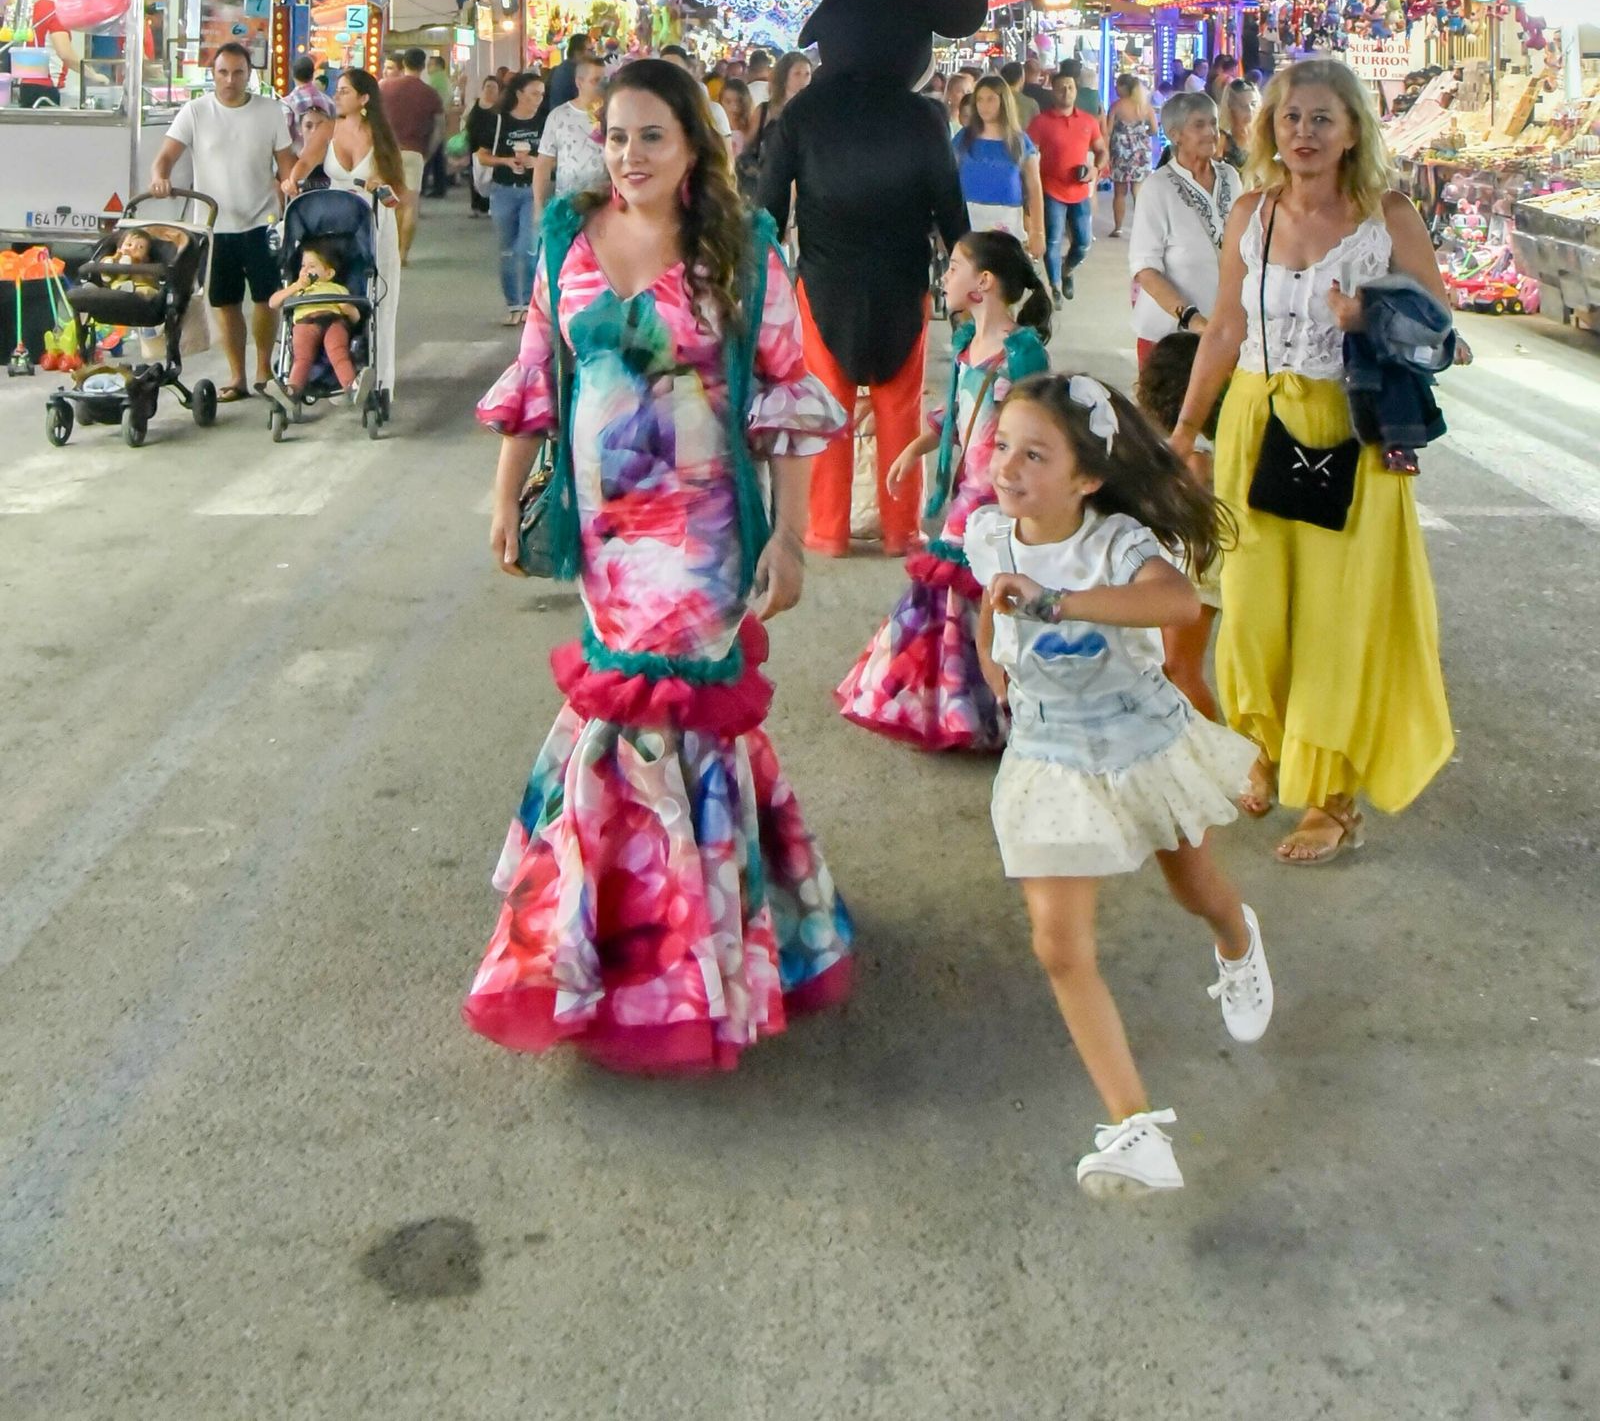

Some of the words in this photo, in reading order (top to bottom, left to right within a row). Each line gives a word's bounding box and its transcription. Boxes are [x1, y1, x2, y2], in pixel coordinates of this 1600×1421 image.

[347, 8, 365, 29] 3
[1353, 56, 1409, 66] TURRON
[1373, 68, 1388, 78] 10
[35, 213, 67, 226] 6417
[72, 215, 96, 227] CYD
